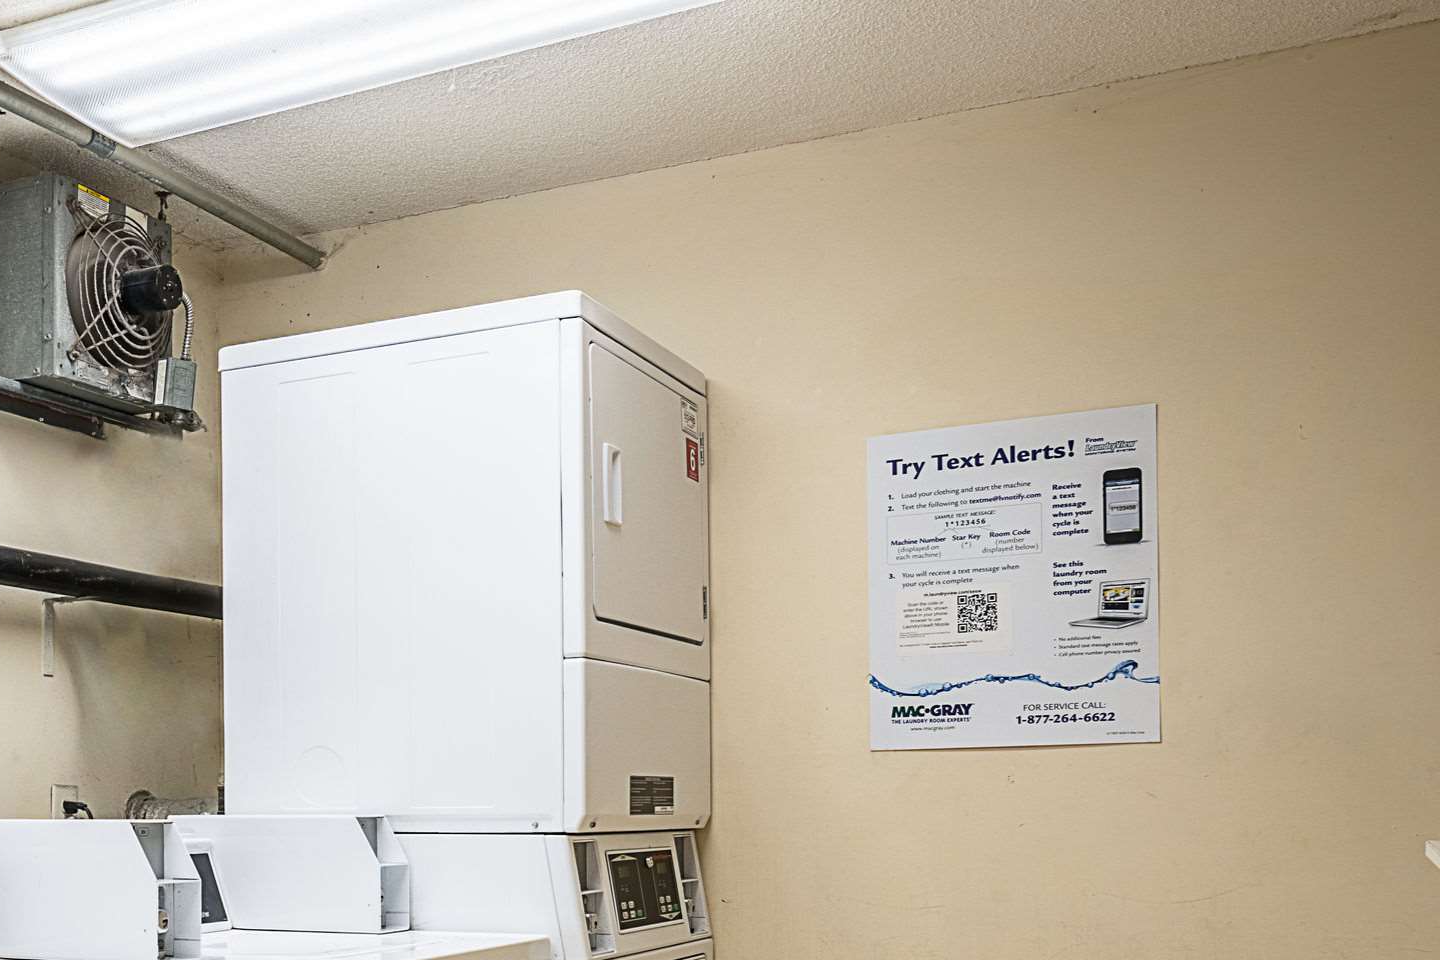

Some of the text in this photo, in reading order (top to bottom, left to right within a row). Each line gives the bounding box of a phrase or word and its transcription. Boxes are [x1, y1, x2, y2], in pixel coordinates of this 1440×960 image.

[690, 448, 696, 471] 6
[886, 440, 1075, 480] Try Text Alerts!
[901, 492, 917, 500] Load
[918, 491, 932, 499] your
[933, 487, 960, 497] clothing
[974, 484, 990, 492] start
[1002, 481, 1031, 489] machine
[928, 500, 959, 509] following
[1052, 501, 1086, 509] message
[1075, 509, 1093, 517] your
[1052, 520, 1071, 529] cycle
[1052, 528, 1089, 536] complete
[919, 536, 946, 544] Number
[968, 533, 981, 541] Key
[972, 565, 1000, 574] message
[1053, 569, 1083, 578] laundry
[902, 581, 917, 589] your
[918, 579, 933, 587] cycle
[942, 577, 973, 586] complete
[1053, 579, 1092, 587] from your
[1053, 588, 1091, 597] computer
[1023, 701, 1107, 712] FOR SERVICE CALL:
[1015, 712, 1116, 725] 1-877-264-6622
